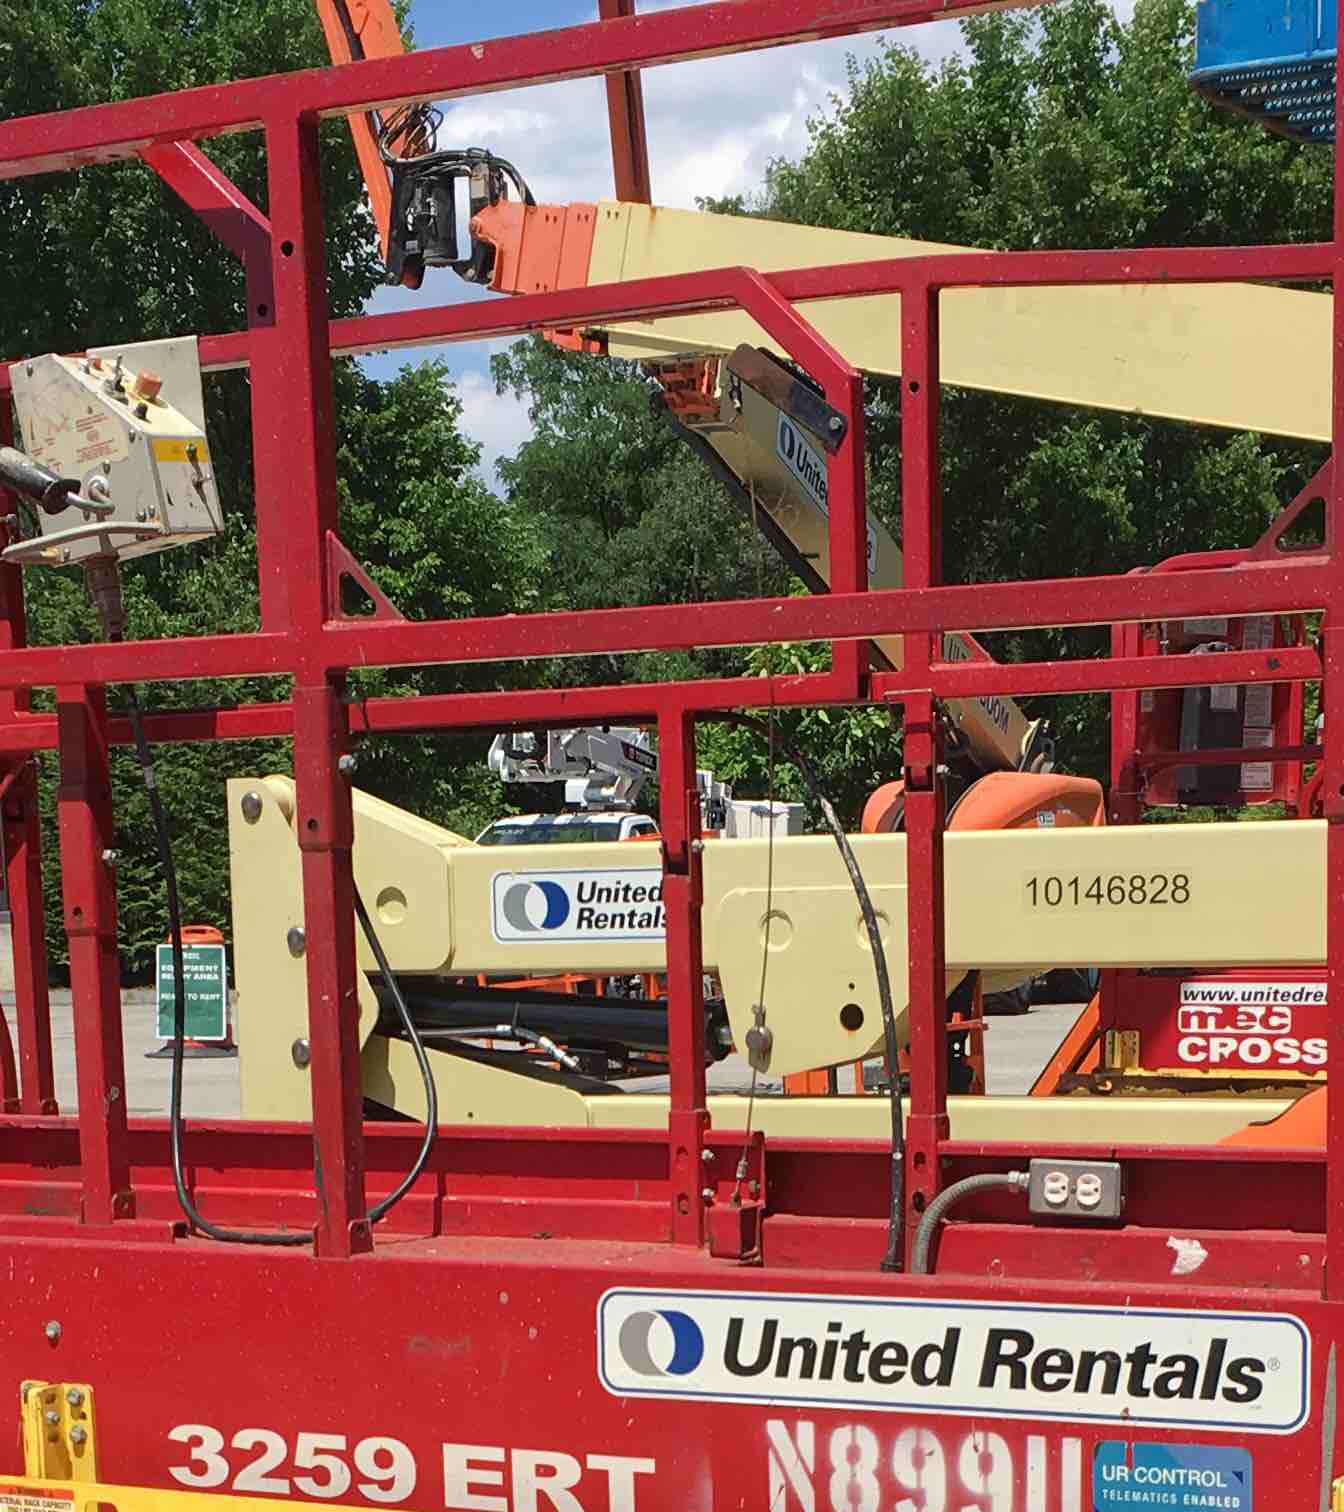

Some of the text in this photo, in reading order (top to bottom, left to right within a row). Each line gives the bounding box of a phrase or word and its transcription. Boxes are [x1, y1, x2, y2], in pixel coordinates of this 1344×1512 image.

[794, 444, 828, 505] Unite
[576, 879, 664, 905] United
[1024, 873, 1192, 906] 10146828
[160, 964, 219, 973] EQPMENT
[722, 1316, 1266, 1404] United Rentals
[166, 1423, 419, 1503] 3259
[1101, 1465, 1229, 1489] UR CONTROL
[1102, 1488, 1241, 1509] TELEMATICS ENABLED
